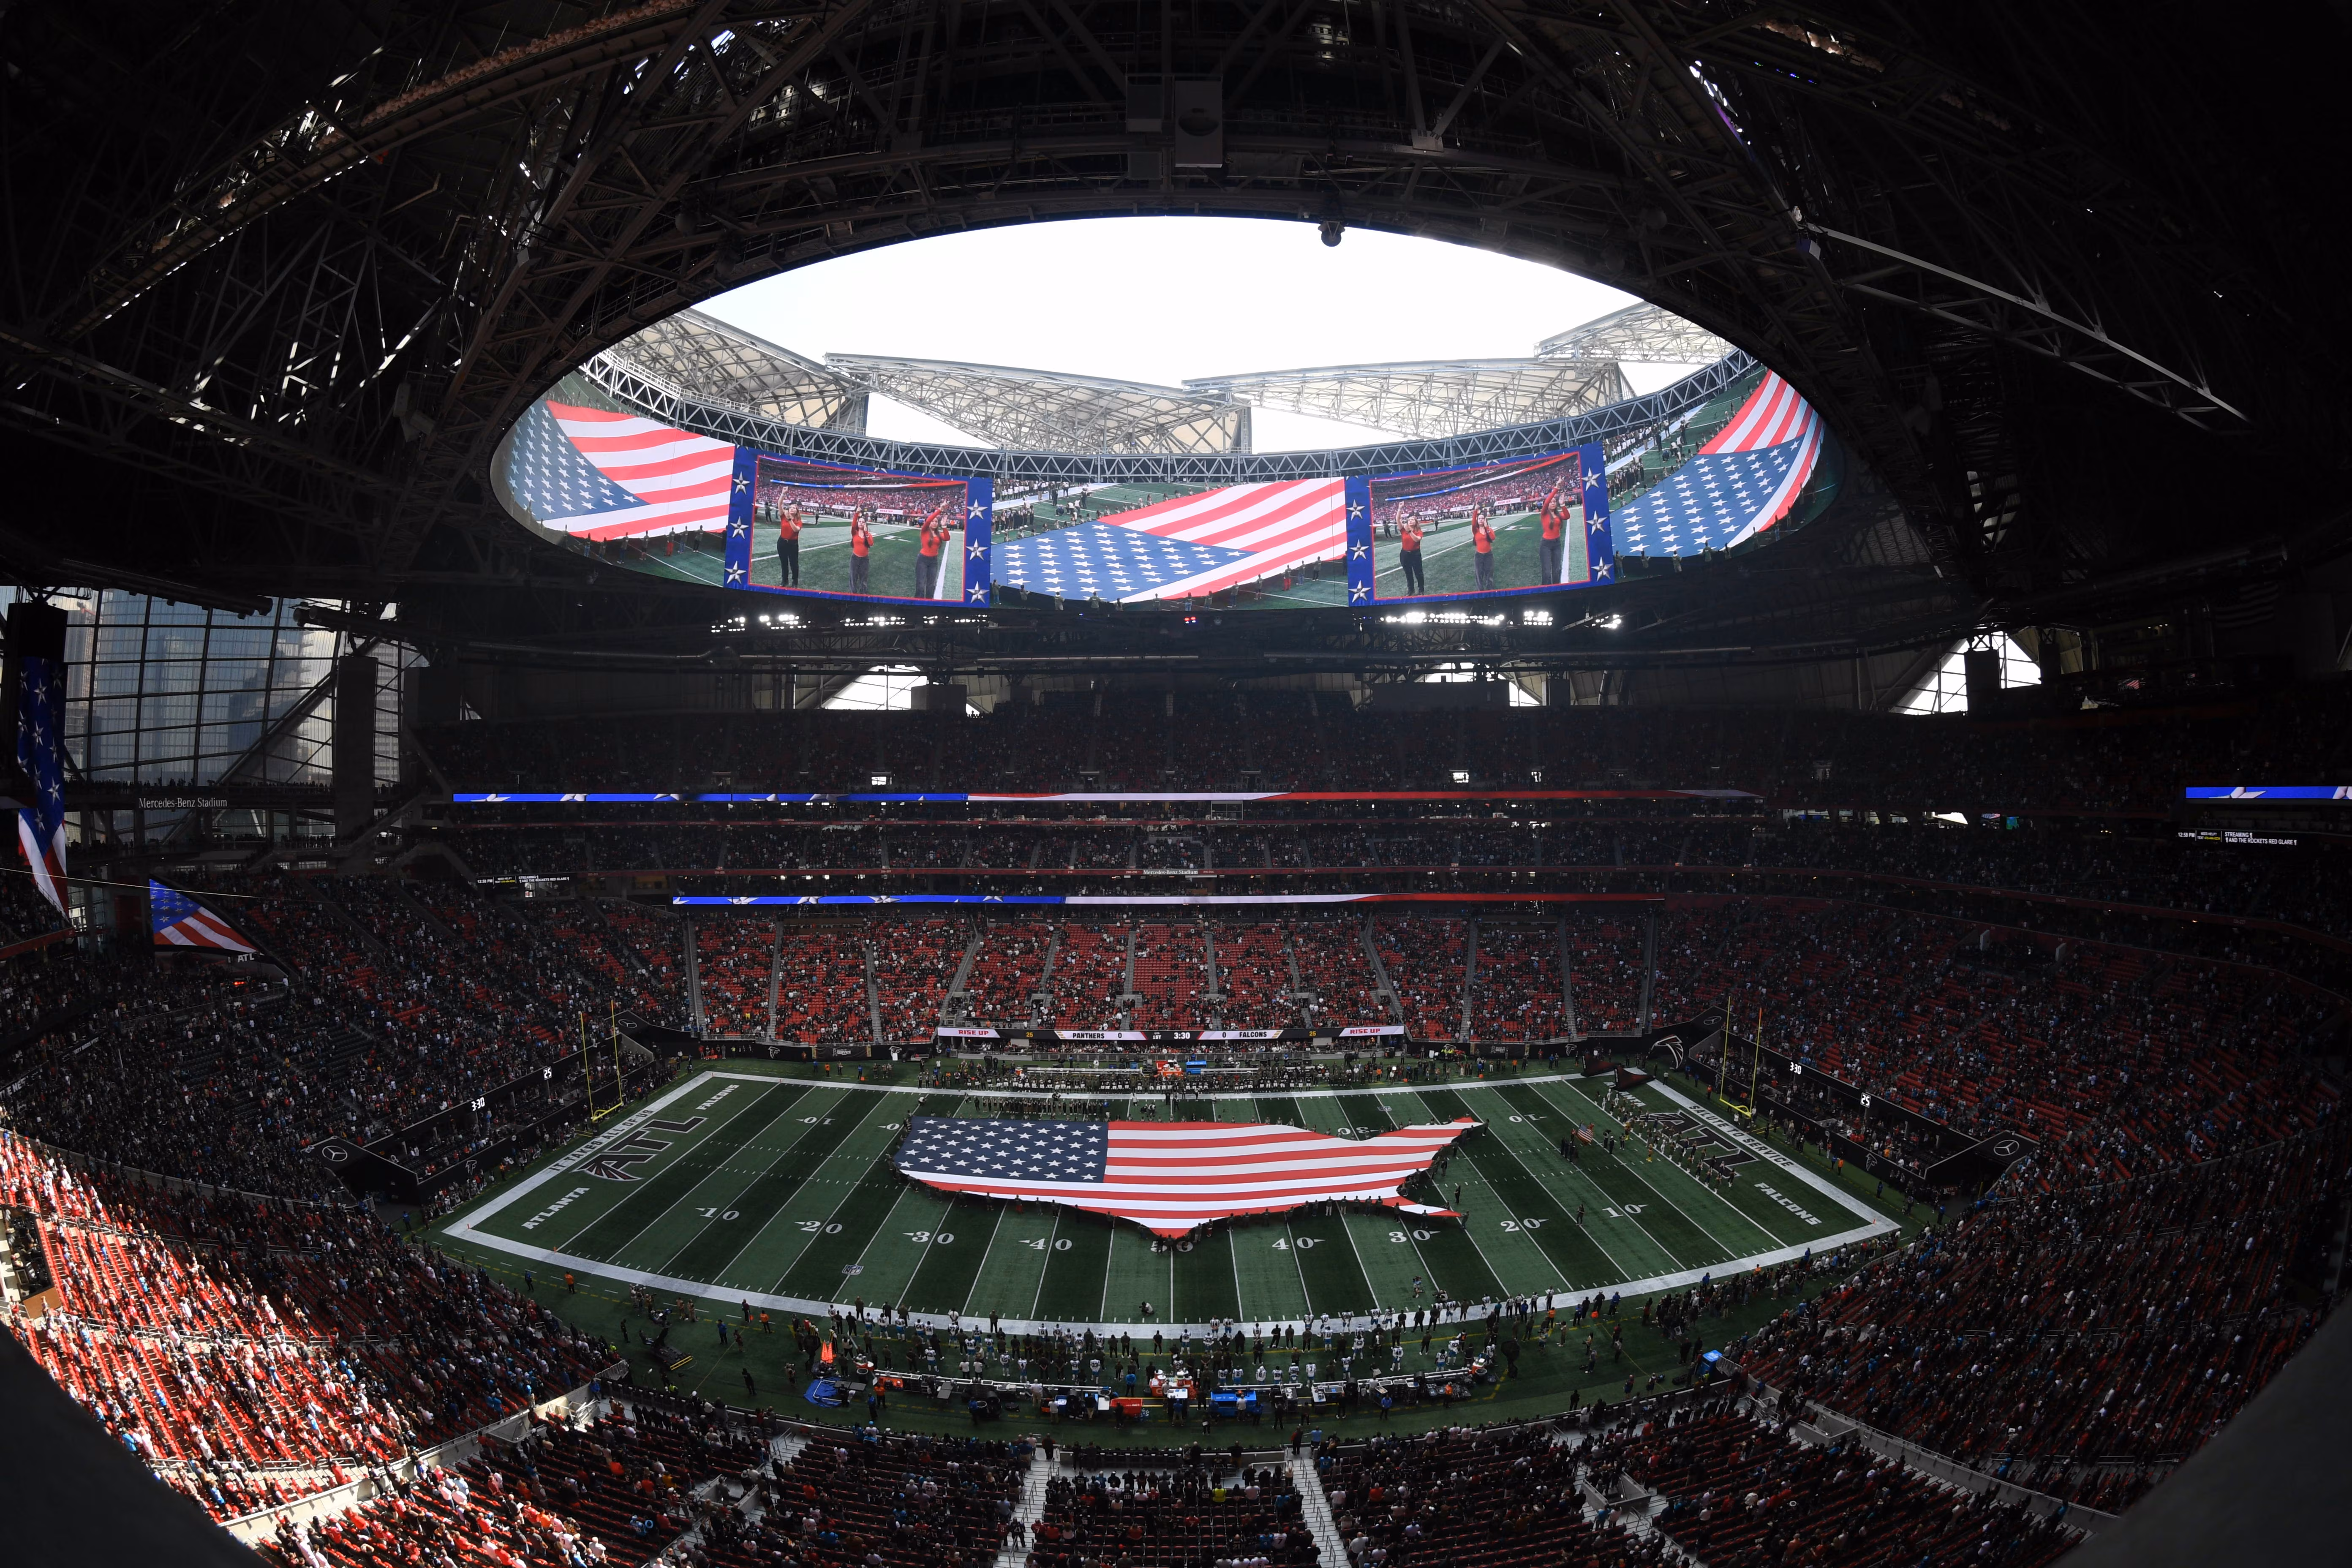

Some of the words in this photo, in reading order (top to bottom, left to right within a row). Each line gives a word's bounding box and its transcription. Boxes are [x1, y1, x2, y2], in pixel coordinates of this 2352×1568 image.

[139, 797, 195, 808] Mercedes-Benz
[197, 797, 227, 807] Stadium
[237, 953, 255, 963] ATL
[543, 1068, 552, 1078] 25
[1789, 1062, 1802, 1075] 3:30
[471, 1097, 485, 1111] 3:30
[695, 1084, 740, 1111] FALCONS
[1861, 1094, 1870, 1106] 25
[549, 1163, 566, 1171] IT
[564, 1141, 602, 1161] TAKES
[602, 1128, 624, 1139] ALL
[622, 1119, 638, 1127] OF
[636, 1109, 653, 1118] US
[1689, 1105, 1727, 1127] SALUTE
[1727, 1127, 1745, 1138] TO
[1742, 1138, 1795, 1168] SERVICE
[569, 1116, 709, 1181] ATL
[521, 1187, 591, 1230] ATLANTA
[1753, 1181, 1823, 1225] FALCONS
